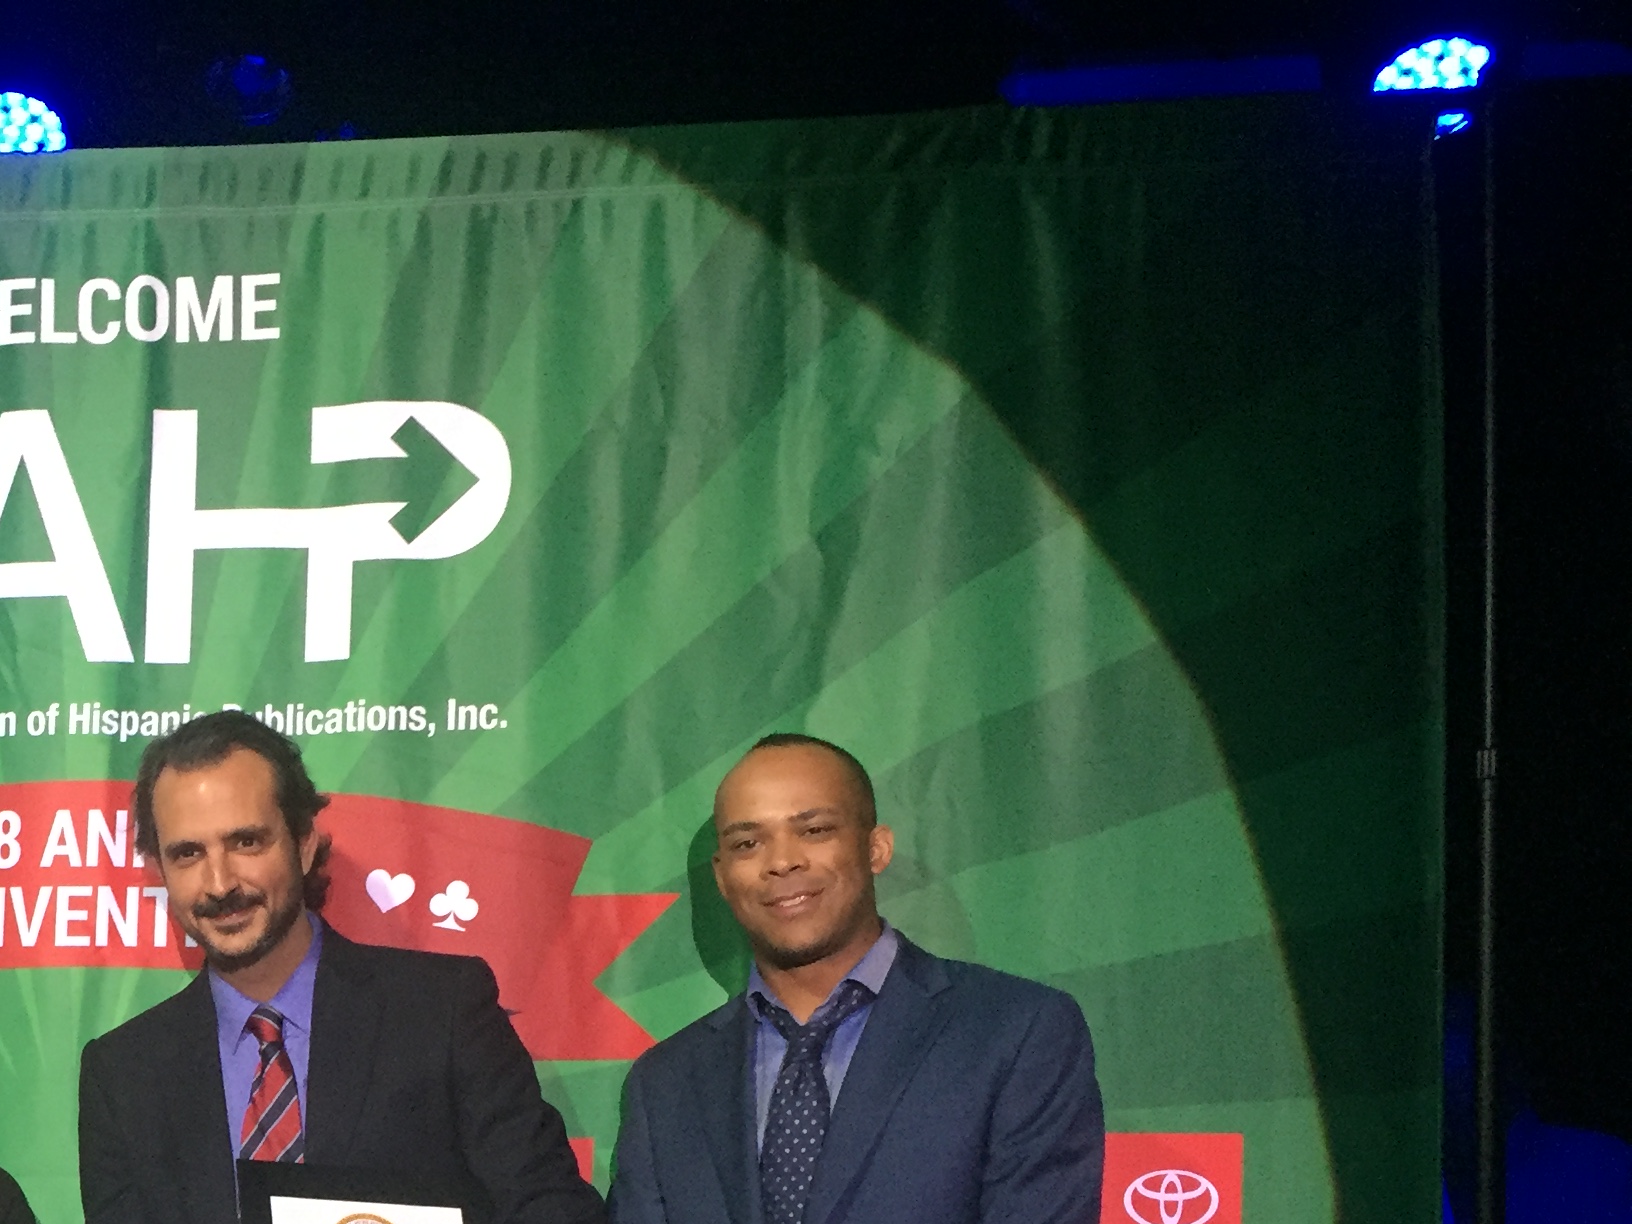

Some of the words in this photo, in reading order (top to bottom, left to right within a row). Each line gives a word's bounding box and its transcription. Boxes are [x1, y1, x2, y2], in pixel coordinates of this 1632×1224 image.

[26, 702, 61, 737] of
[221, 697, 436, 738] blications,
[446, 698, 509, 732] Inc.
